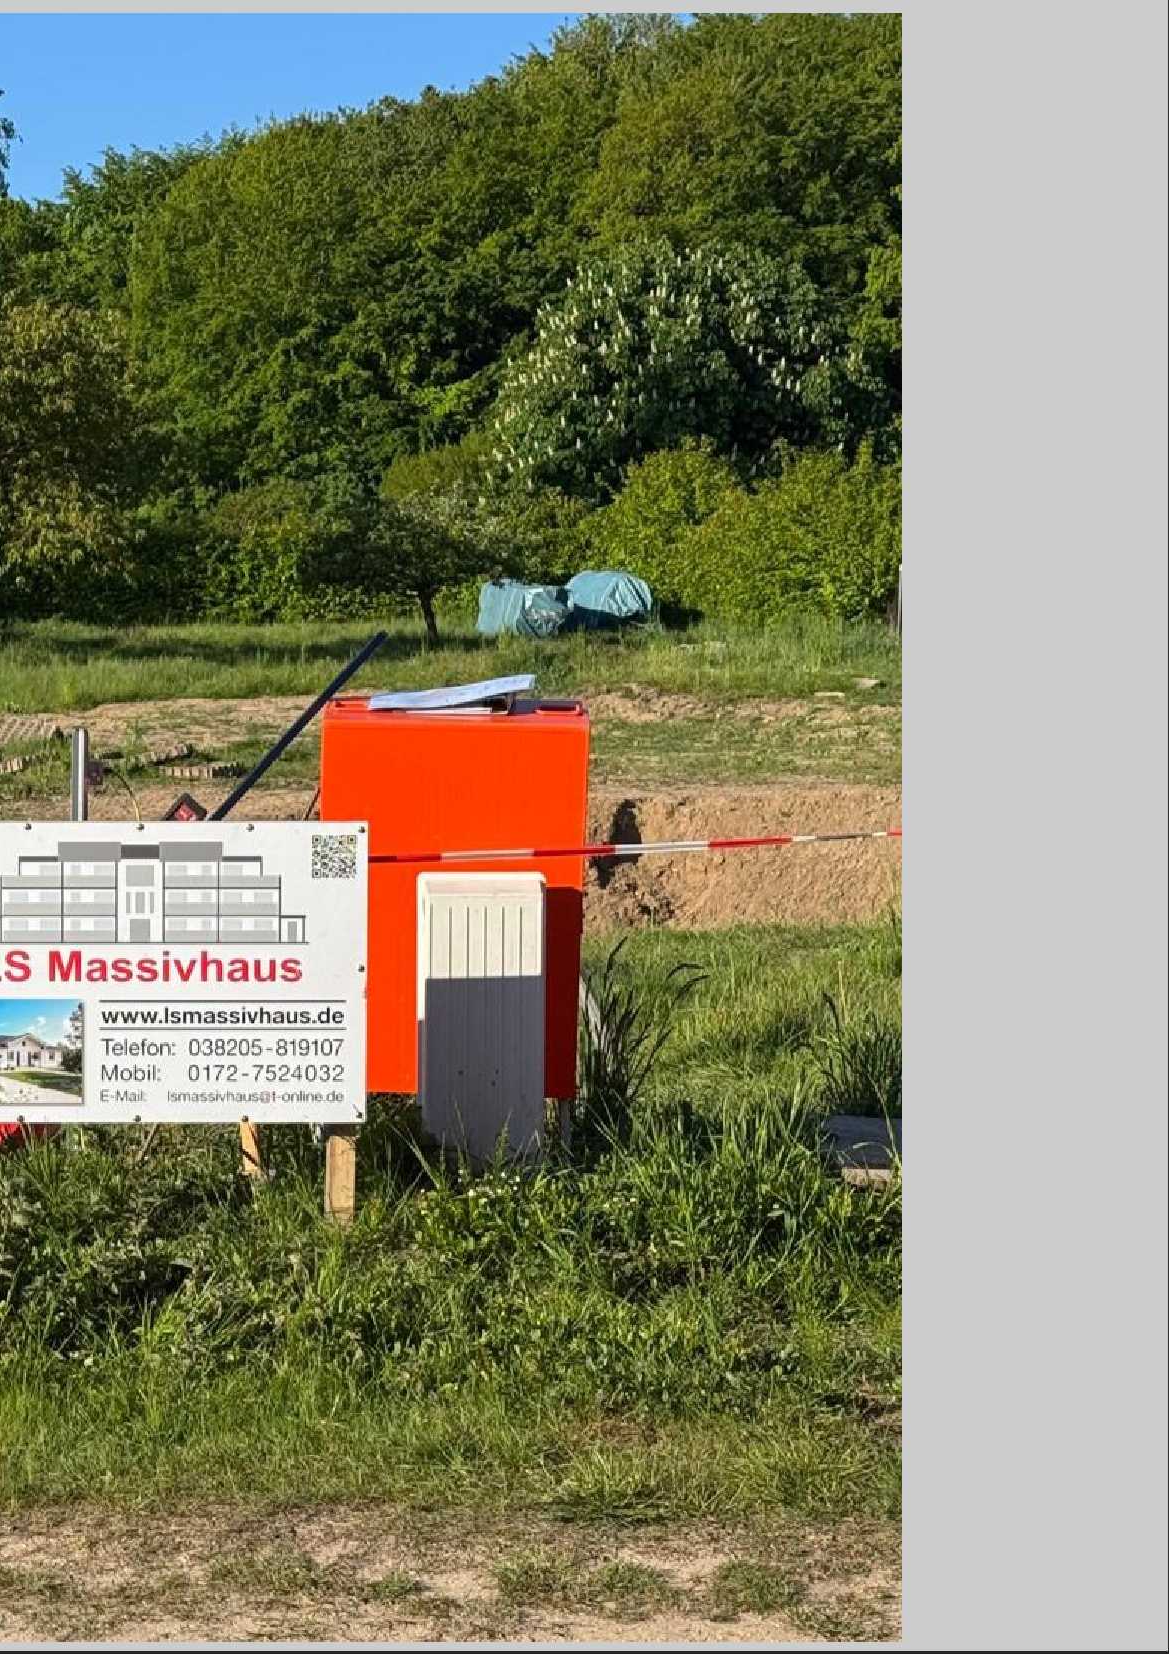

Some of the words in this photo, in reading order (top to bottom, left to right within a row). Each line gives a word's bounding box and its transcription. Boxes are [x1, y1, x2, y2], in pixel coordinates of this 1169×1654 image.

[48, 949, 303, 983] Massivhaus
[101, 1006, 345, 1025] www.lsmassivhaus.de
[100, 1038, 176, 1057] Telefon:
[101, 1064, 162, 1083] Mobil:
[99, 1089, 147, 1103] E-Mail:
[167, 1089, 345, 1104] lsmassivhaus@t-online.de
